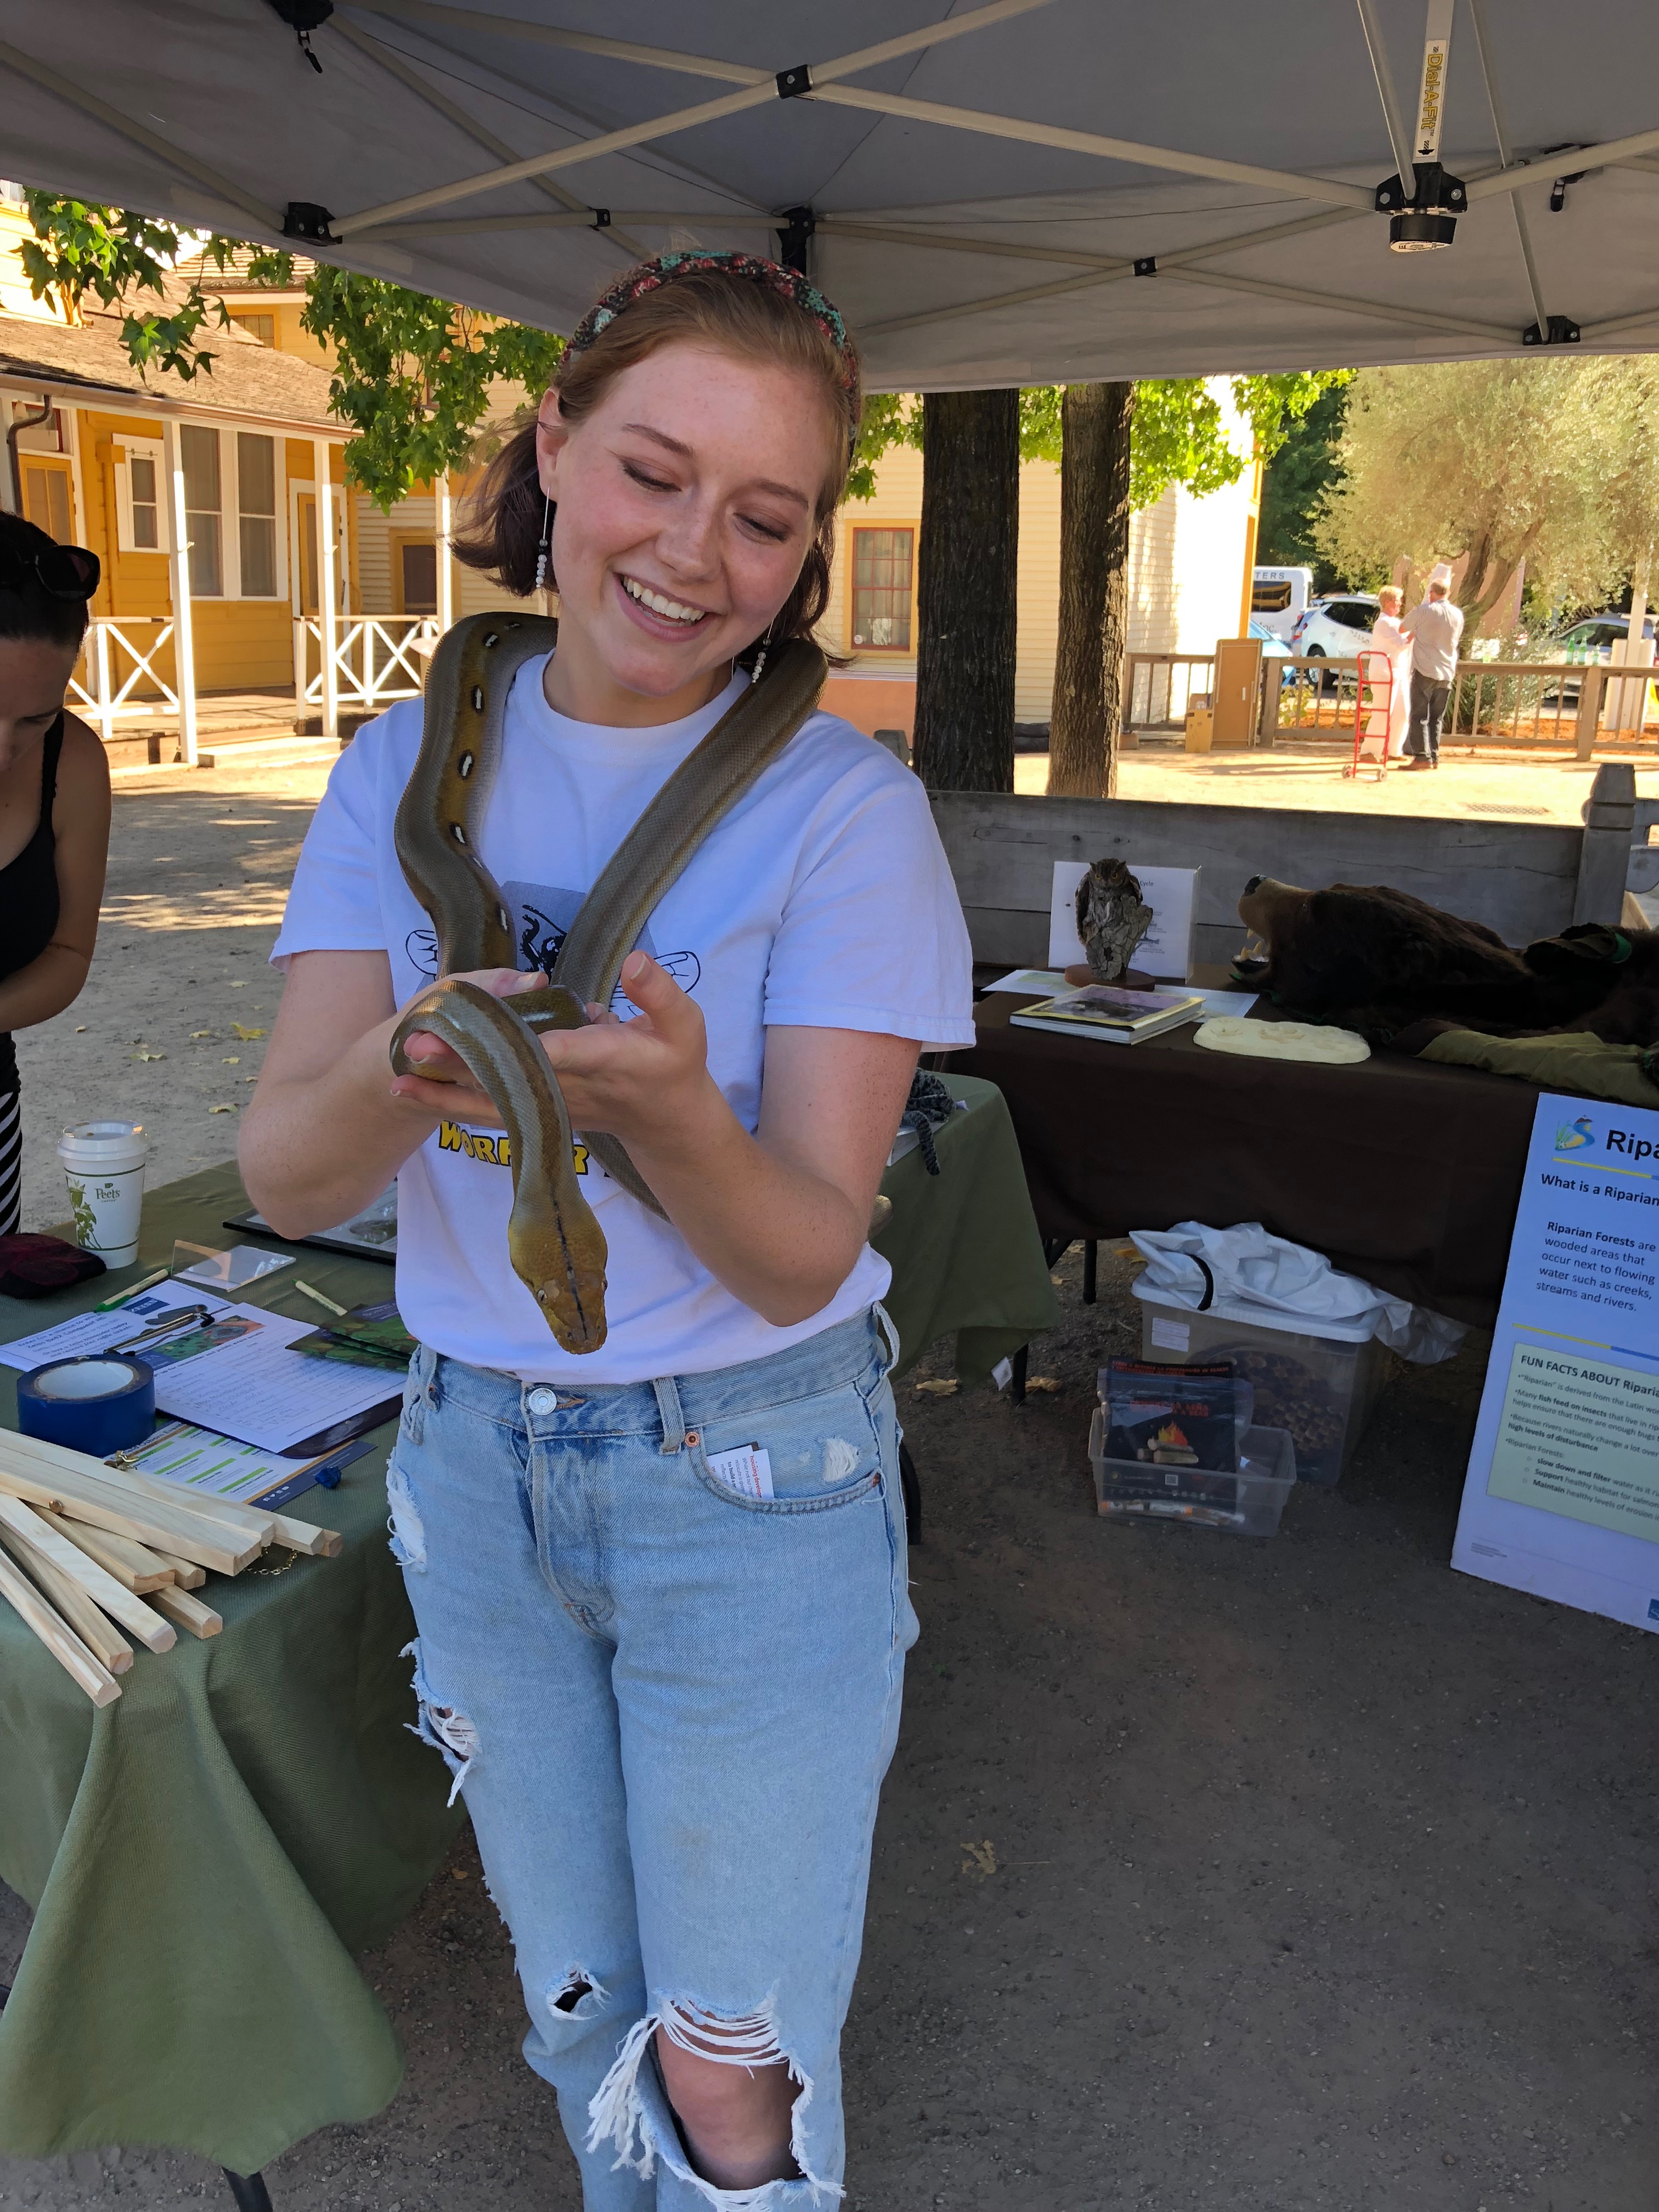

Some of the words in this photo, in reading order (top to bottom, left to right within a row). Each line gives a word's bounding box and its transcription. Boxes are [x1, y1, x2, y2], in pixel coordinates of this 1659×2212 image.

[1541, 1173, 1576, 1190] What
[1579, 1181, 1589, 1193] is
[1593, 1186, 1600, 1195] a
[1605, 1186, 1659, 1206] Riparian
[1545, 1238, 1588, 1253] wooded
[1590, 1248, 1619, 1260] areas
[1623, 1253, 1645, 1266] that
[1548, 1221, 1592, 1238] Riparian
[1595, 1232, 1635, 1248] Forests
[1638, 1242, 1656, 1252] are
[1539, 1267, 1569, 1280] water
[1572, 1274, 1596, 1286] such
[1599, 1280, 1611, 1289] as
[1614, 1284, 1652, 1300] creeks,
[1542, 1253, 1571, 1265] occur
[1573, 1260, 1597, 1271] next
[1600, 1264, 1611, 1274] to
[1615, 1266, 1655, 1285] flowing
[1536, 1282, 1577, 1297] streams
[1581, 1292, 1601, 1303] and
[1604, 1296, 1637, 1311] rivers.
[1521, 1355, 1543, 1368] FUN
[1546, 1361, 1578, 1376] FACTS
[1580, 1370, 1620, 1387] ABOUT
[1517, 1389, 1537, 1401] Many
[1538, 1394, 1551, 1403] fish
[1553, 1398, 1569, 1407] feed
[1582, 1405, 1607, 1417] insects
[1609, 1412, 1623, 1421] that
[1625, 1417, 1638, 1425] live
[1565, 1386, 1591, 1397] derived
[1593, 1392, 1610, 1402] from
[1612, 1397, 1624, 1406] the
[1626, 1401, 1644, 1410] Latin
[1513, 1398, 1531, 1408] helps
[1532, 1404, 1556, 1414] ensure
[1558, 1410, 1572, 1419] that
[1574, 1414, 1593, 1424] there
[1608, 1424, 1636, 1435] enough
[1637, 1430, 1655, 1441] bugs
[1508, 1423, 1523, 1432] high
[1525, 1426, 1545, 1437] levels
[1555, 1435, 1598, 1452] disturbance
[1508, 1438, 1536, 1451] Riparian
[1513, 1414, 1541, 1426] Because
[1543, 1422, 1561, 1432] rivers
[1564, 1428, 1595, 1441] naturally
[1596, 1436, 1622, 1448] change
[1630, 1443, 1640, 1452] lot
[1642, 1449, 1659, 1457] over
[749, 1455, 758, 1477] housing
[1537, 1458, 1554, 1467] slow
[1555, 1463, 1576, 1473] down
[1578, 1469, 1592, 1477] and
[1593, 1472, 1611, 1482] filter
[1613, 1480, 1633, 1489] water
[1534, 1468, 1563, 1481] Support
[1565, 1476, 1592, 1490] healthy
[1593, 1485, 1618, 1497] habitat
[1533, 1480, 1565, 1493] Maintain
[1566, 1489, 1593, 1503] healthy
[1594, 1497, 1615, 1508] levels
[1626, 1507, 1653, 1519] erosion
